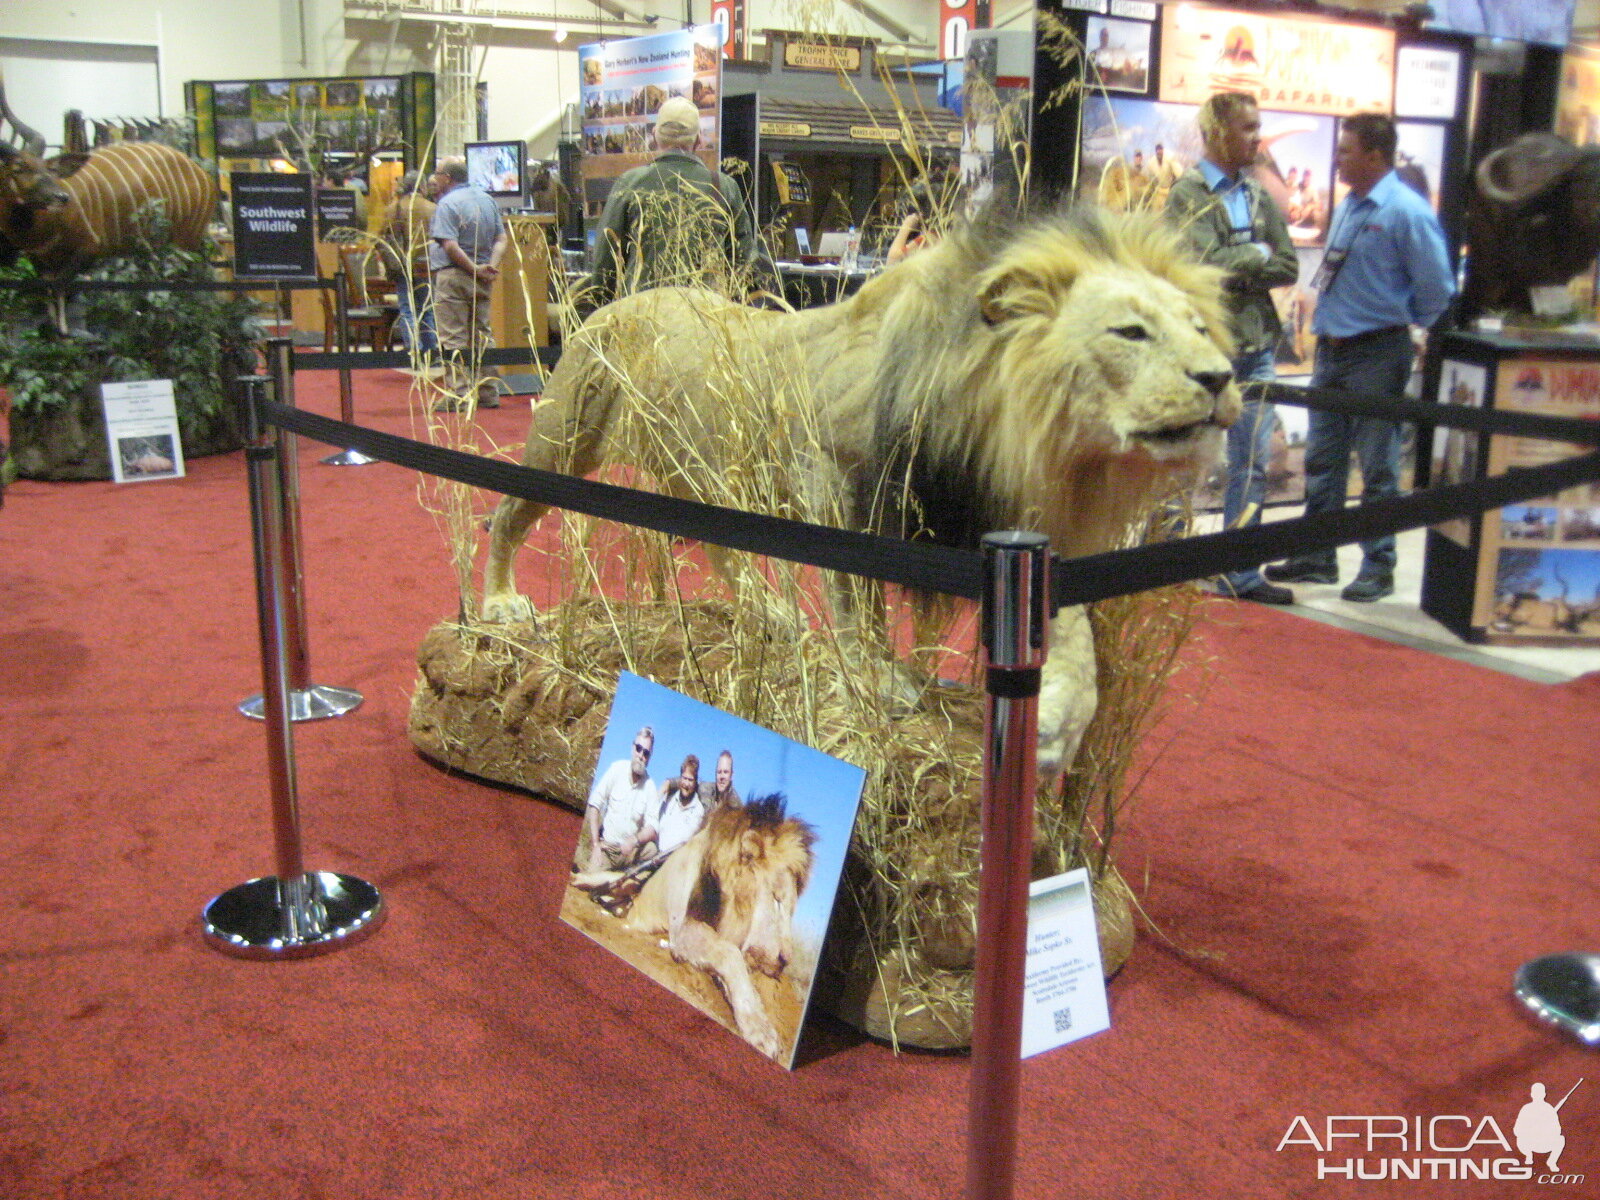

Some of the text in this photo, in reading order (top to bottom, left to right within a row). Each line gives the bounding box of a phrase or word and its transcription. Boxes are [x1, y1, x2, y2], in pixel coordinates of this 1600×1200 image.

[638, 55, 650, 64] New
[650, 53, 670, 63] Zealand
[670, 49, 691, 60] Hunting
[799, 45, 826, 55] TROPHY
[795, 56, 826, 65] GENERAL
[1260, 88, 1355, 108] SAFARIS
[240, 206, 306, 219] Southwest
[249, 220, 298, 233] Wildlife
